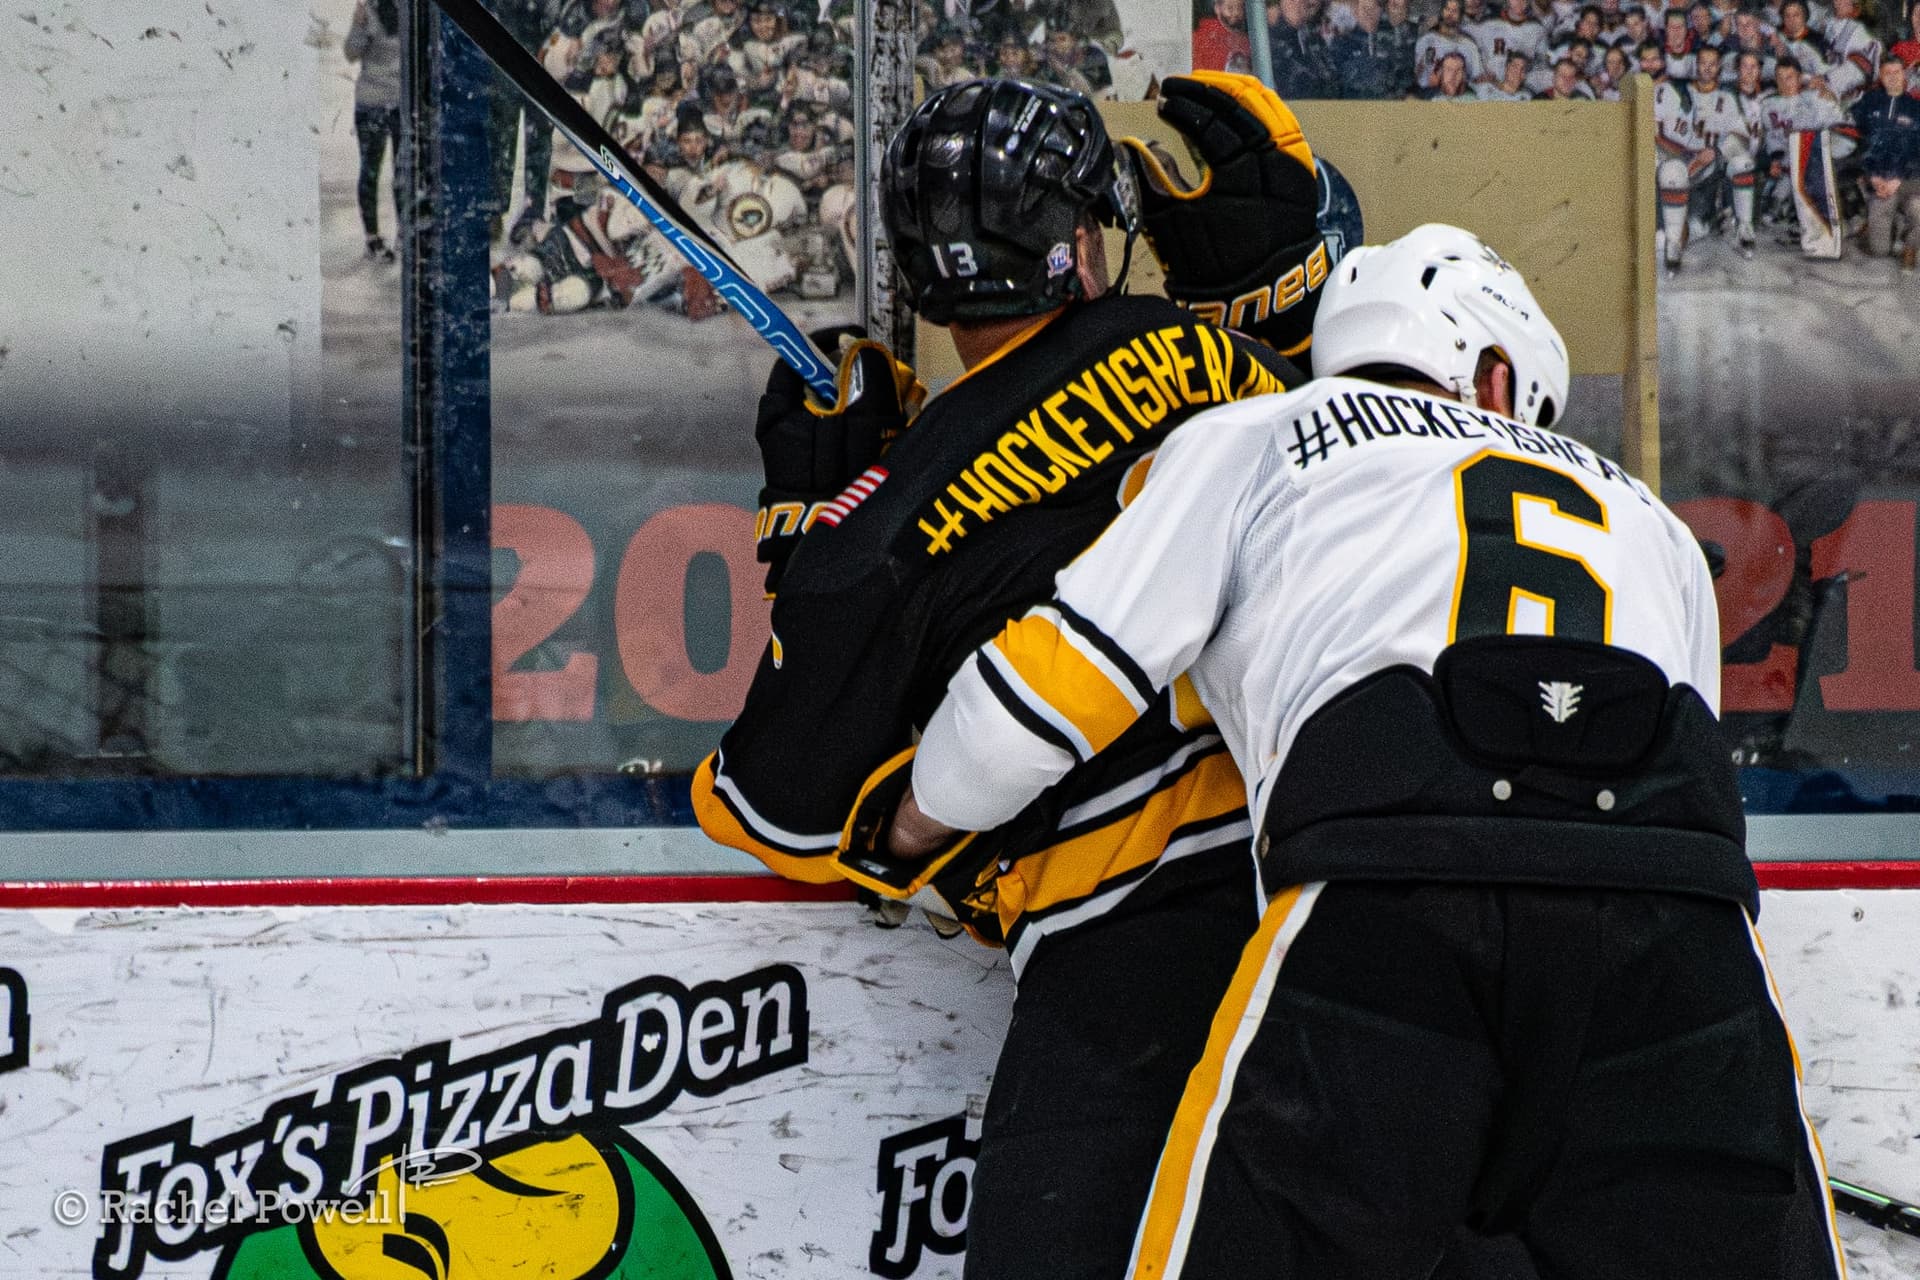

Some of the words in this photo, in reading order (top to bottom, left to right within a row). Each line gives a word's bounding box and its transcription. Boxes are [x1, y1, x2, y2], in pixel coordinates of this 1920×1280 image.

[931, 242, 979, 280] 13
[490, 501, 771, 722] 20
[1447, 447, 1613, 647] 6
[107, 1114, 329, 1272] Fox's
[340, 1039, 593, 1198] Pizza
[603, 980, 793, 1109] Den
[884, 1136, 977, 1264] Fo
